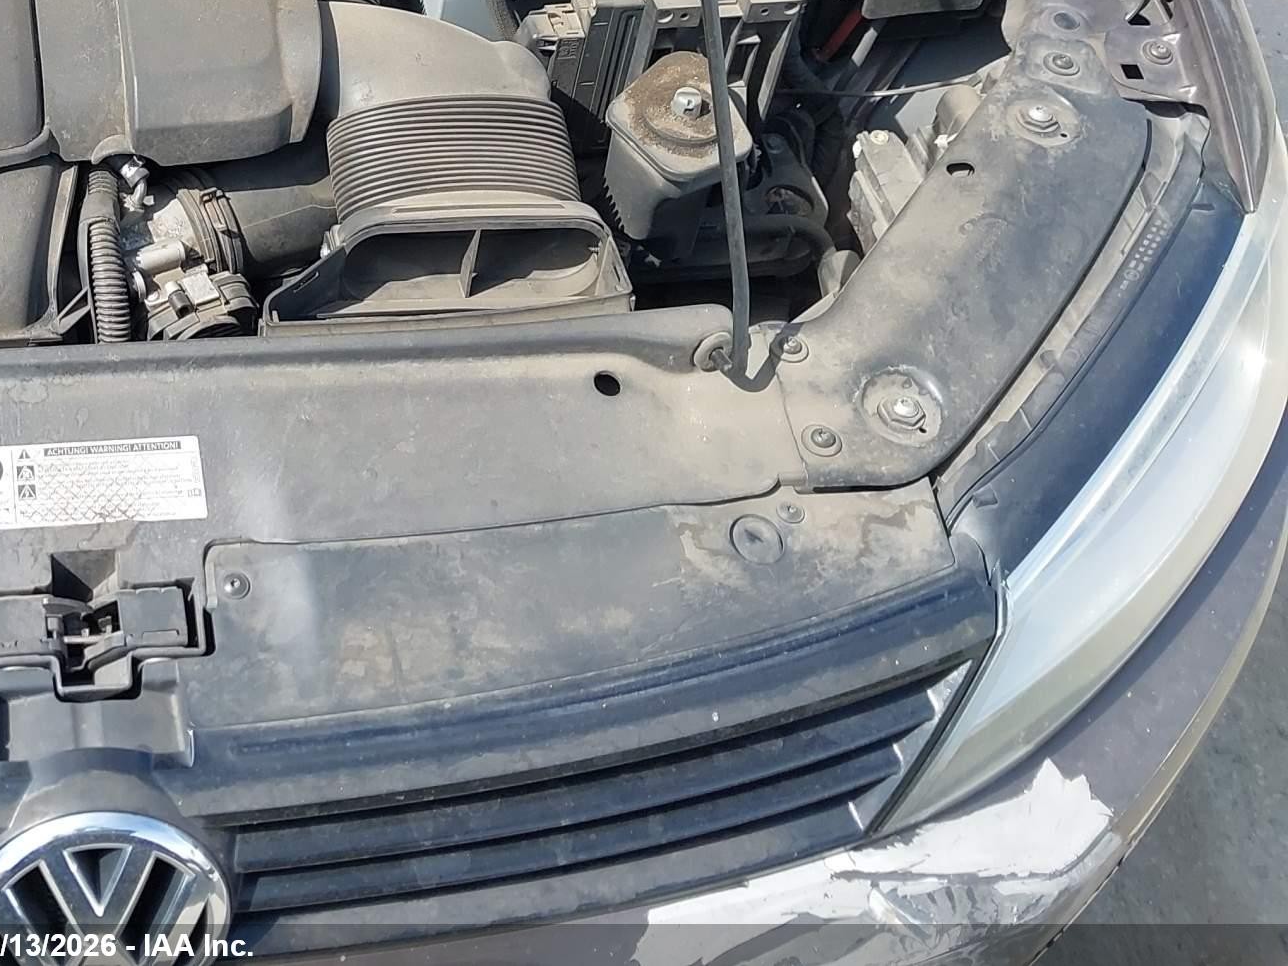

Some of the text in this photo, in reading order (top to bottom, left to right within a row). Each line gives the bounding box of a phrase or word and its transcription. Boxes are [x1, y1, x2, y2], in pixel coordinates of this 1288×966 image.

[47, 441, 179, 457] ACHTUNG! WARNING! ATTENTION!
